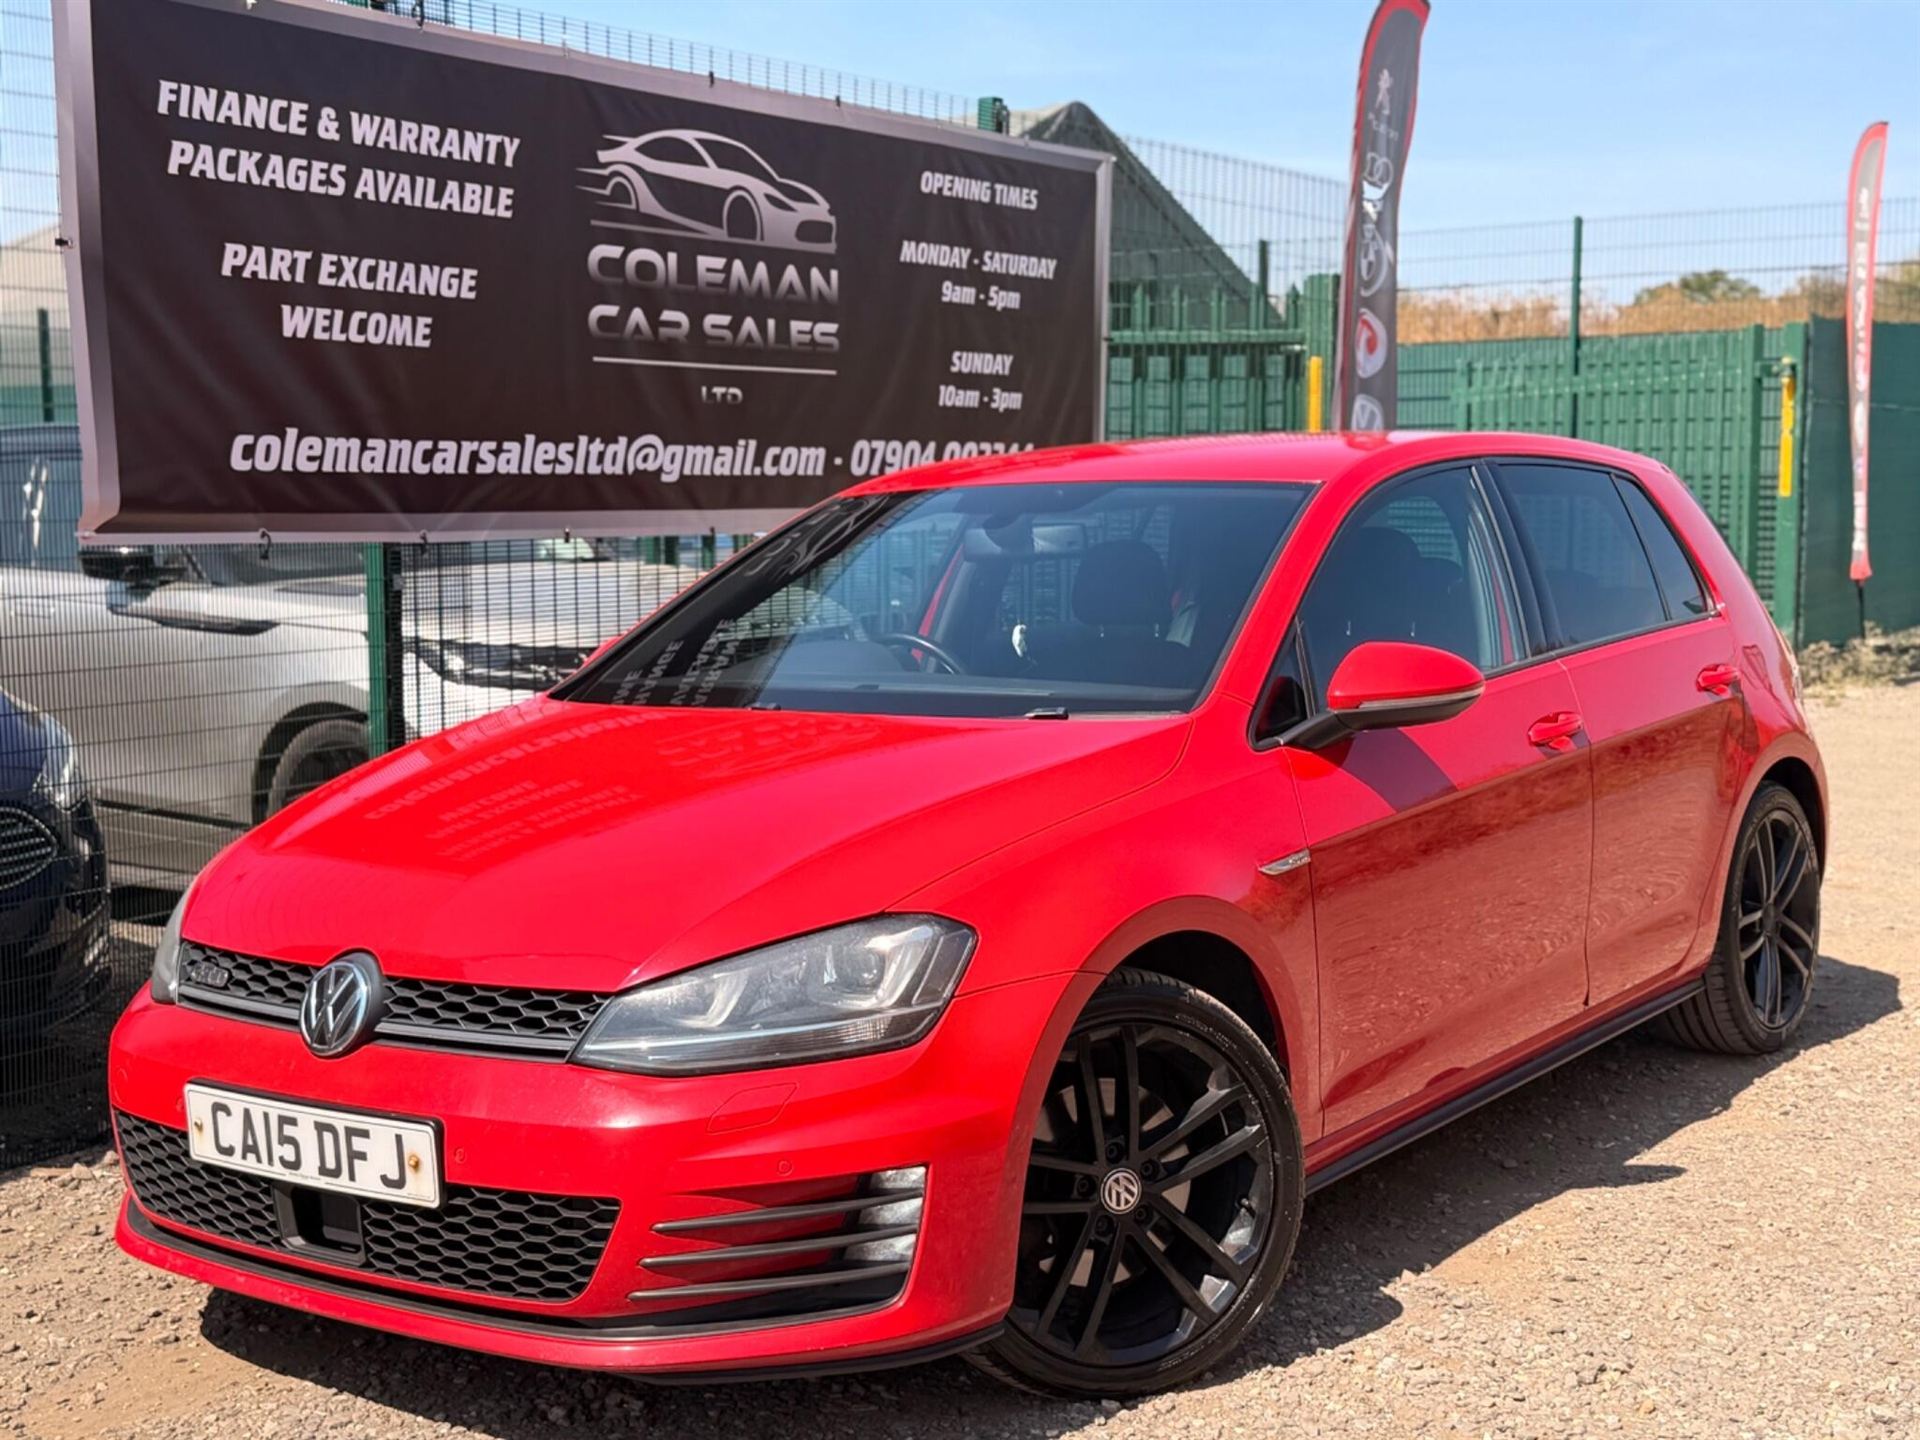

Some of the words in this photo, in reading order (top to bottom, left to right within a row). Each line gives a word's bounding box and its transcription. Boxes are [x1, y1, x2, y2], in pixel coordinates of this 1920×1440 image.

[158, 80, 309, 136] FINANCE
[317, 107, 340, 141] &
[350, 111, 520, 168] WARRANTY
[167, 140, 346, 196] PACKAGES
[354, 169, 515, 219] AVAILABLE
[920, 171, 991, 202] OPENING
[994, 183, 1039, 210] TIMES
[221, 243, 312, 283] PART
[318, 254, 478, 299] EXCHANGE
[587, 244, 839, 304] COLEMAN
[900, 240, 971, 269] MONDAY
[981, 251, 1057, 280] SATURDAY
[941, 281, 976, 305] 9am
[987, 286, 1021, 311] 5pm
[280, 304, 432, 347] WELCOME
[587, 304, 691, 345] CAR
[703, 314, 840, 352] SALES
[950, 351, 1013, 376] SUNDAY
[701, 386, 743, 405] LTD
[938, 385, 980, 408] 10am
[990, 388, 1023, 412] 3pm
[230, 427, 826, 483] colemancarsalesltd@gmail.com
[210, 1101, 300, 1171] CA15
